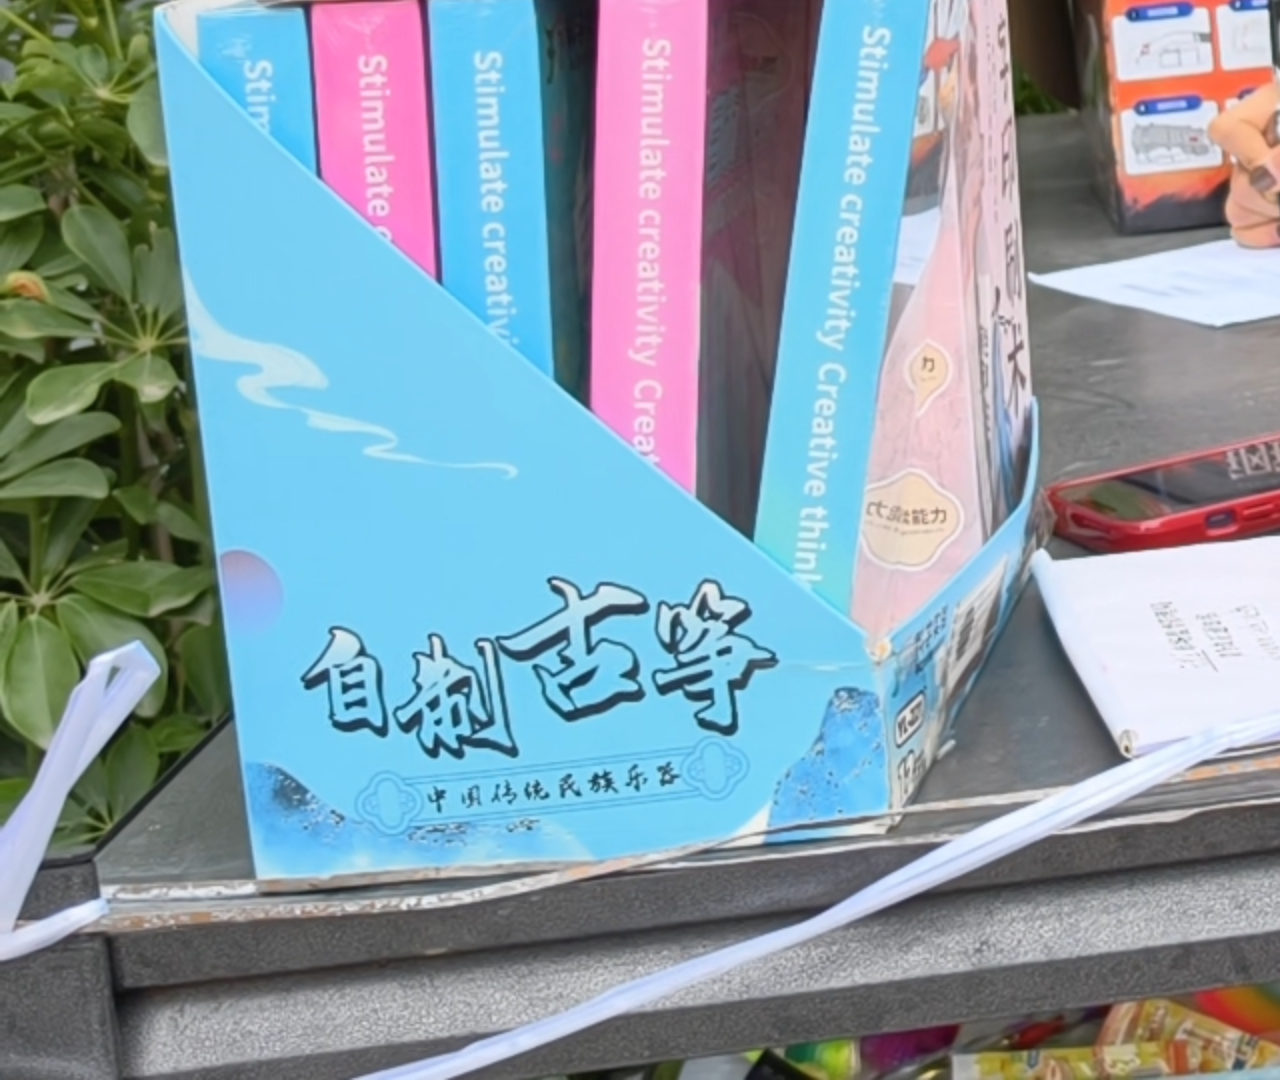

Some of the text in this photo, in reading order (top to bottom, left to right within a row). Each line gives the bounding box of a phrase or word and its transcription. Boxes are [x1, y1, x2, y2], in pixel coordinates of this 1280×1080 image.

[357, 54, 396, 218] Stimulate
[637, 37, 673, 201] Stimulate
[843, 24, 893, 187] Stimulate
[474, 50, 520, 346] Stimulate creativ
[815, 193, 862, 352] creativity
[628, 208, 668, 368] creativity
[803, 361, 848, 498] Creative
[302, 576, 779, 760] 自制古筝
[425, 761, 683, 813] 中国传统民族乐器
